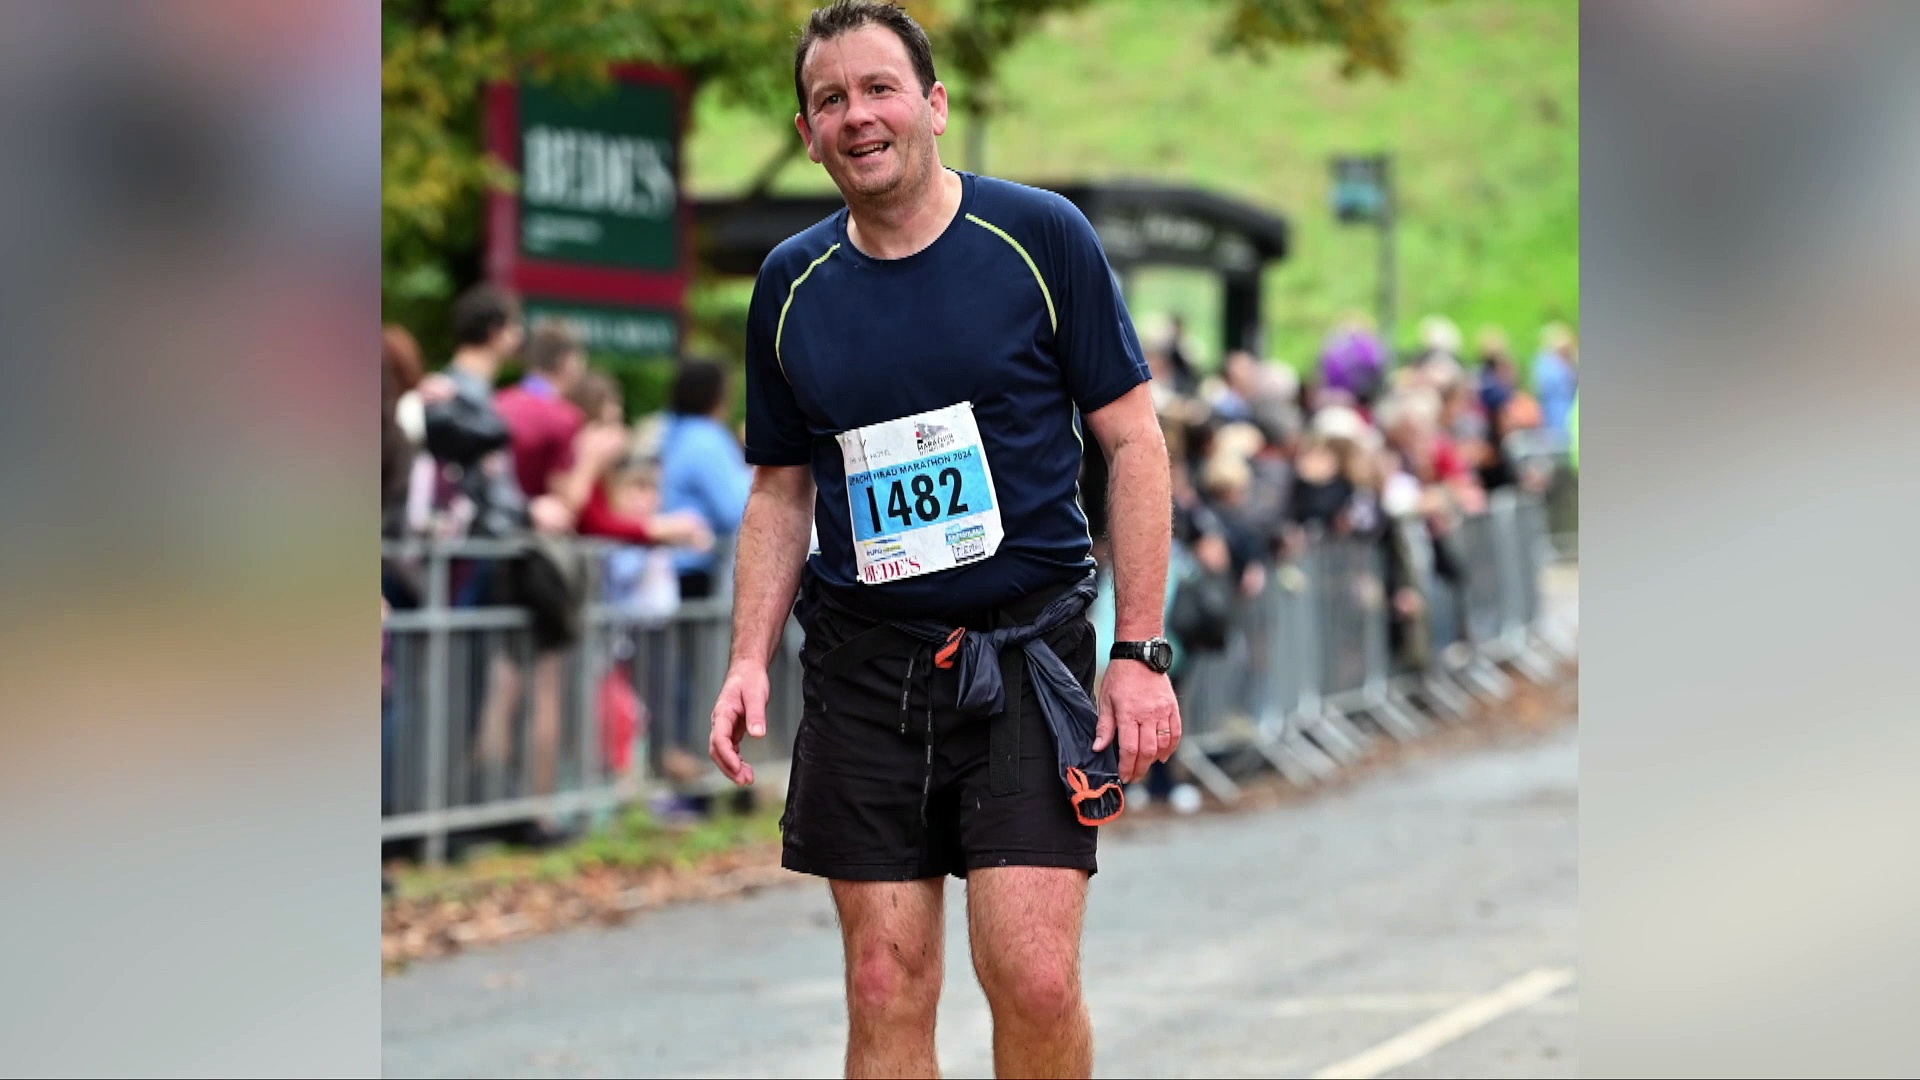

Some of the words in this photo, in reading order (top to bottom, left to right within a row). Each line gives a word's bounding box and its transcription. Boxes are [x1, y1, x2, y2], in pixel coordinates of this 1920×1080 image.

[873, 468, 898, 480] HEAD
[900, 456, 951, 474] MARATHON
[953, 450, 972, 462] 2024
[866, 467, 969, 534] 1482
[864, 557, 921, 582] BEDE'S
